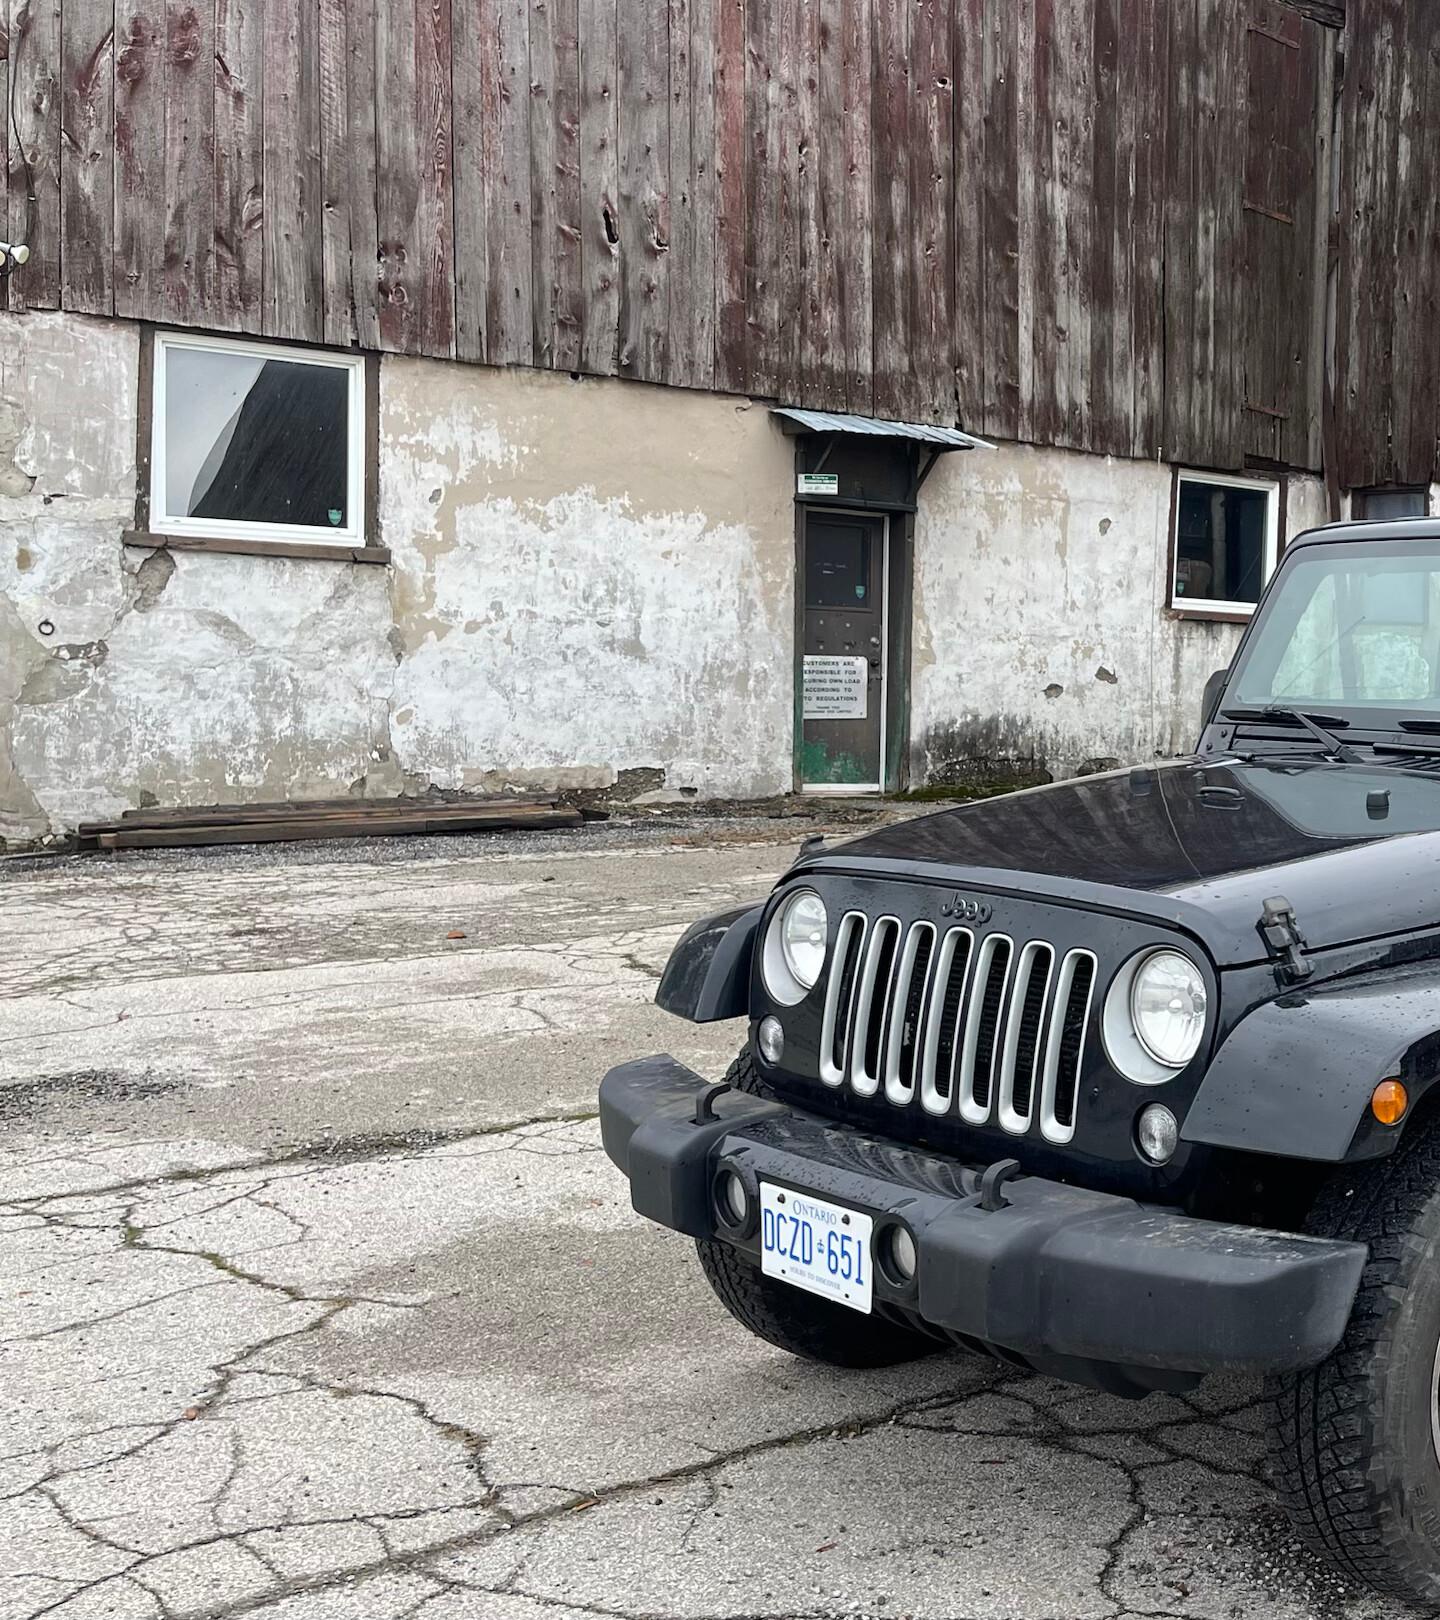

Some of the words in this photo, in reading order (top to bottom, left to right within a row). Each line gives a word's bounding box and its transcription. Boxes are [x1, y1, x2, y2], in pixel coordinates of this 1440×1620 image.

[939, 892, 993, 928] Jeep
[763, 1208, 813, 1265] DCZD
[827, 1229, 864, 1286] 651
